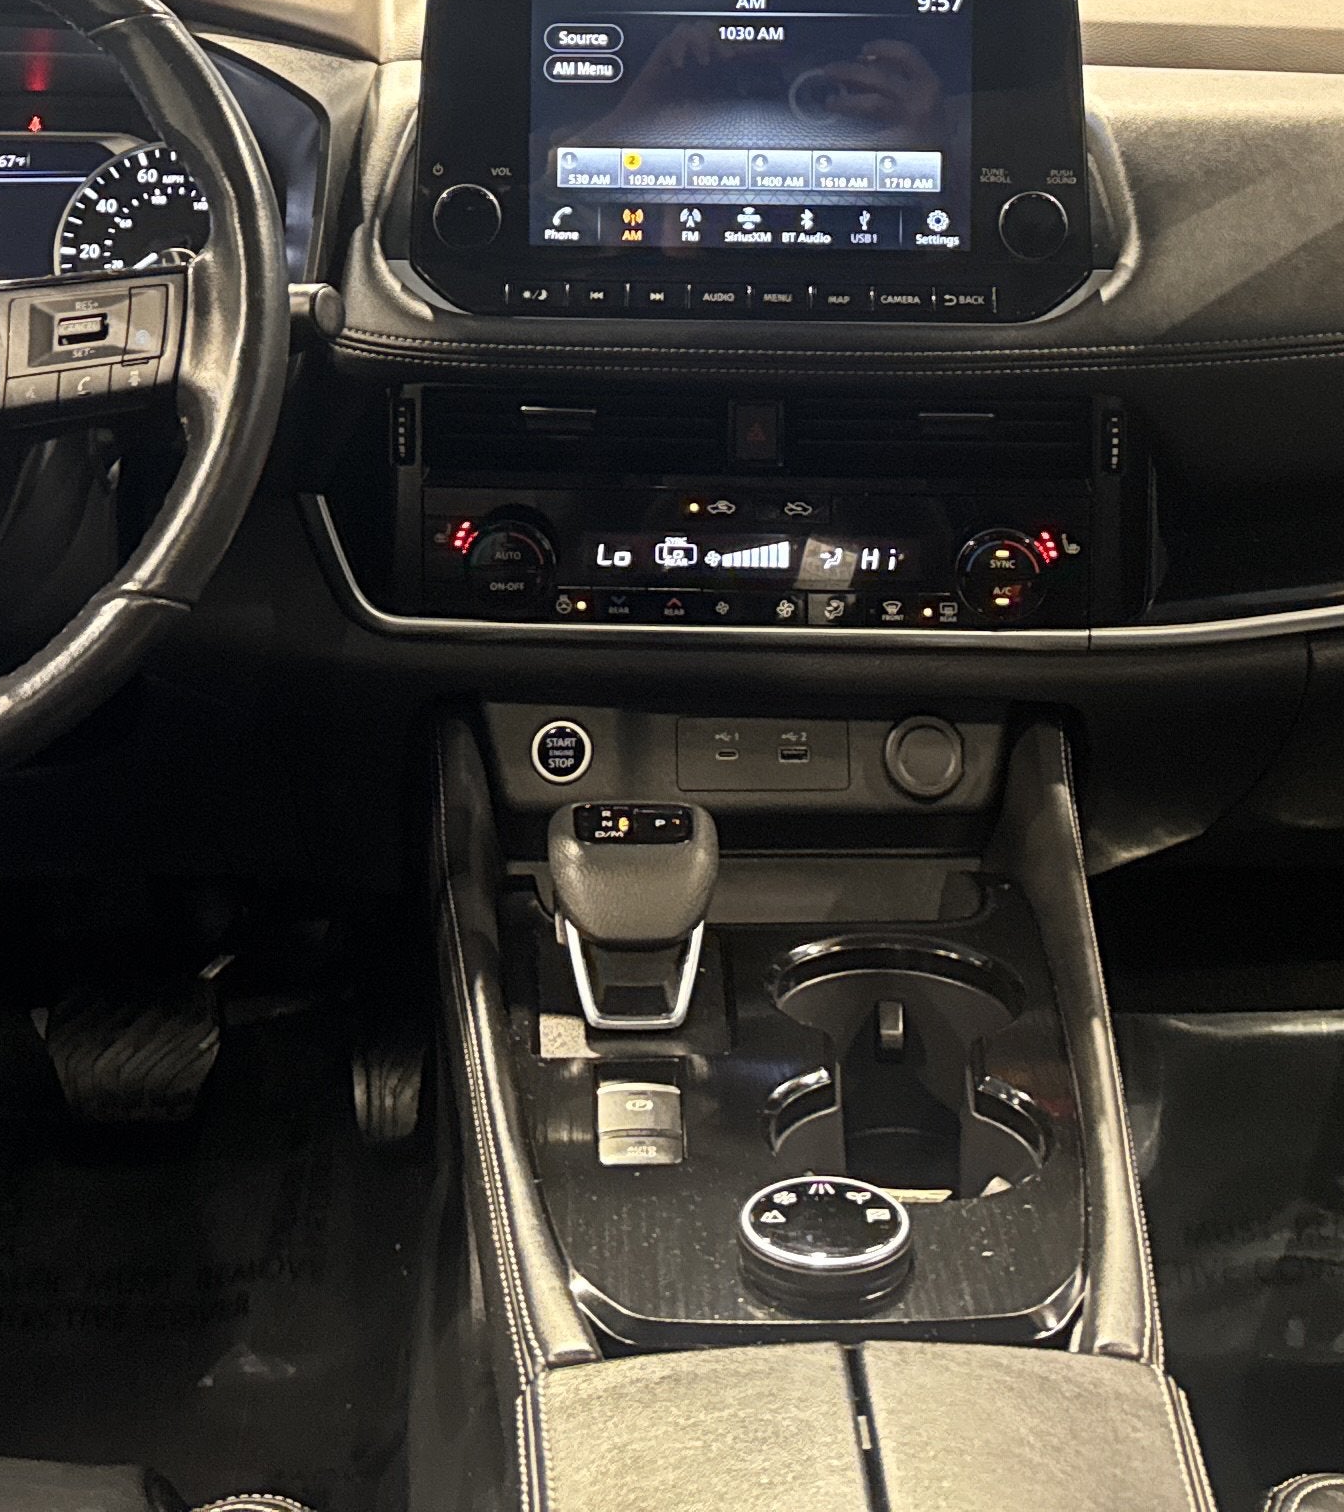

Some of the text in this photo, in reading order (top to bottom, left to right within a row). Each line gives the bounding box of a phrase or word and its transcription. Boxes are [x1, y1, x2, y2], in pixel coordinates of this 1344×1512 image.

[558, 29, 609, 46] Source
[718, 25, 785, 42] 1030 AM
[552, 61, 614, 77] AM Menu
[566, 155, 573, 165] 1
[629, 156, 637, 166] 2
[692, 156, 701, 168] 3
[755, 157, 765, 169] 4
[819, 158, 828, 170] 5
[883, 159, 893, 170] 6
[137, 168, 159, 184] 60
[490, 167, 512, 176] VOL
[1050, 169, 1074, 177] PUSH
[162, 174, 185, 185] MPH
[568, 174, 612, 186] 530 AM
[628, 175, 677, 187] 1030 AM
[719, 175, 741, 187] AM
[755, 176, 805, 188] 1400 AM
[846, 177, 869, 189] AM
[912, 178, 935, 190] AM
[979, 176, 1013, 185] SCROLL
[1046, 177, 1078, 186] SOUND
[95, 198, 118, 214] 40
[543, 226, 580, 242] Phone
[620, 227, 644, 241] AM
[680, 228, 701, 242] FM
[723, 228, 773, 245] SiriusXM
[780, 230, 832, 245] BT Audio
[914, 232, 961, 248] Settings
[78, 243, 101, 260] 20
[702, 292, 735, 303] AUDIO
[763, 293, 794, 303] MENU
[827, 295, 850, 305] MAP
[880, 294, 922, 305] CAMERA
[958, 295, 986, 306] BACK
[495, 550, 522, 561] AUTO
[595, 543, 632, 568] Lo
[861, 546, 897, 570] Hi
[990, 559, 1016, 569] SYNC
[992, 586, 1013, 596] A/C
[608, 606, 630, 615] REAR
[663, 608, 686, 616] REAR
[881, 614, 905, 622] FRONT
[939, 615, 958, 623] REAR
[801, 731, 808, 742] 2
[546, 737, 578, 748] START
[548, 749, 575, 757] ENGINE
[548, 757, 575, 769] STOP
[601, 810, 612, 818] R
[602, 819, 614, 828] N
[654, 818, 667, 828] P
[594, 830, 625, 839] D/M
